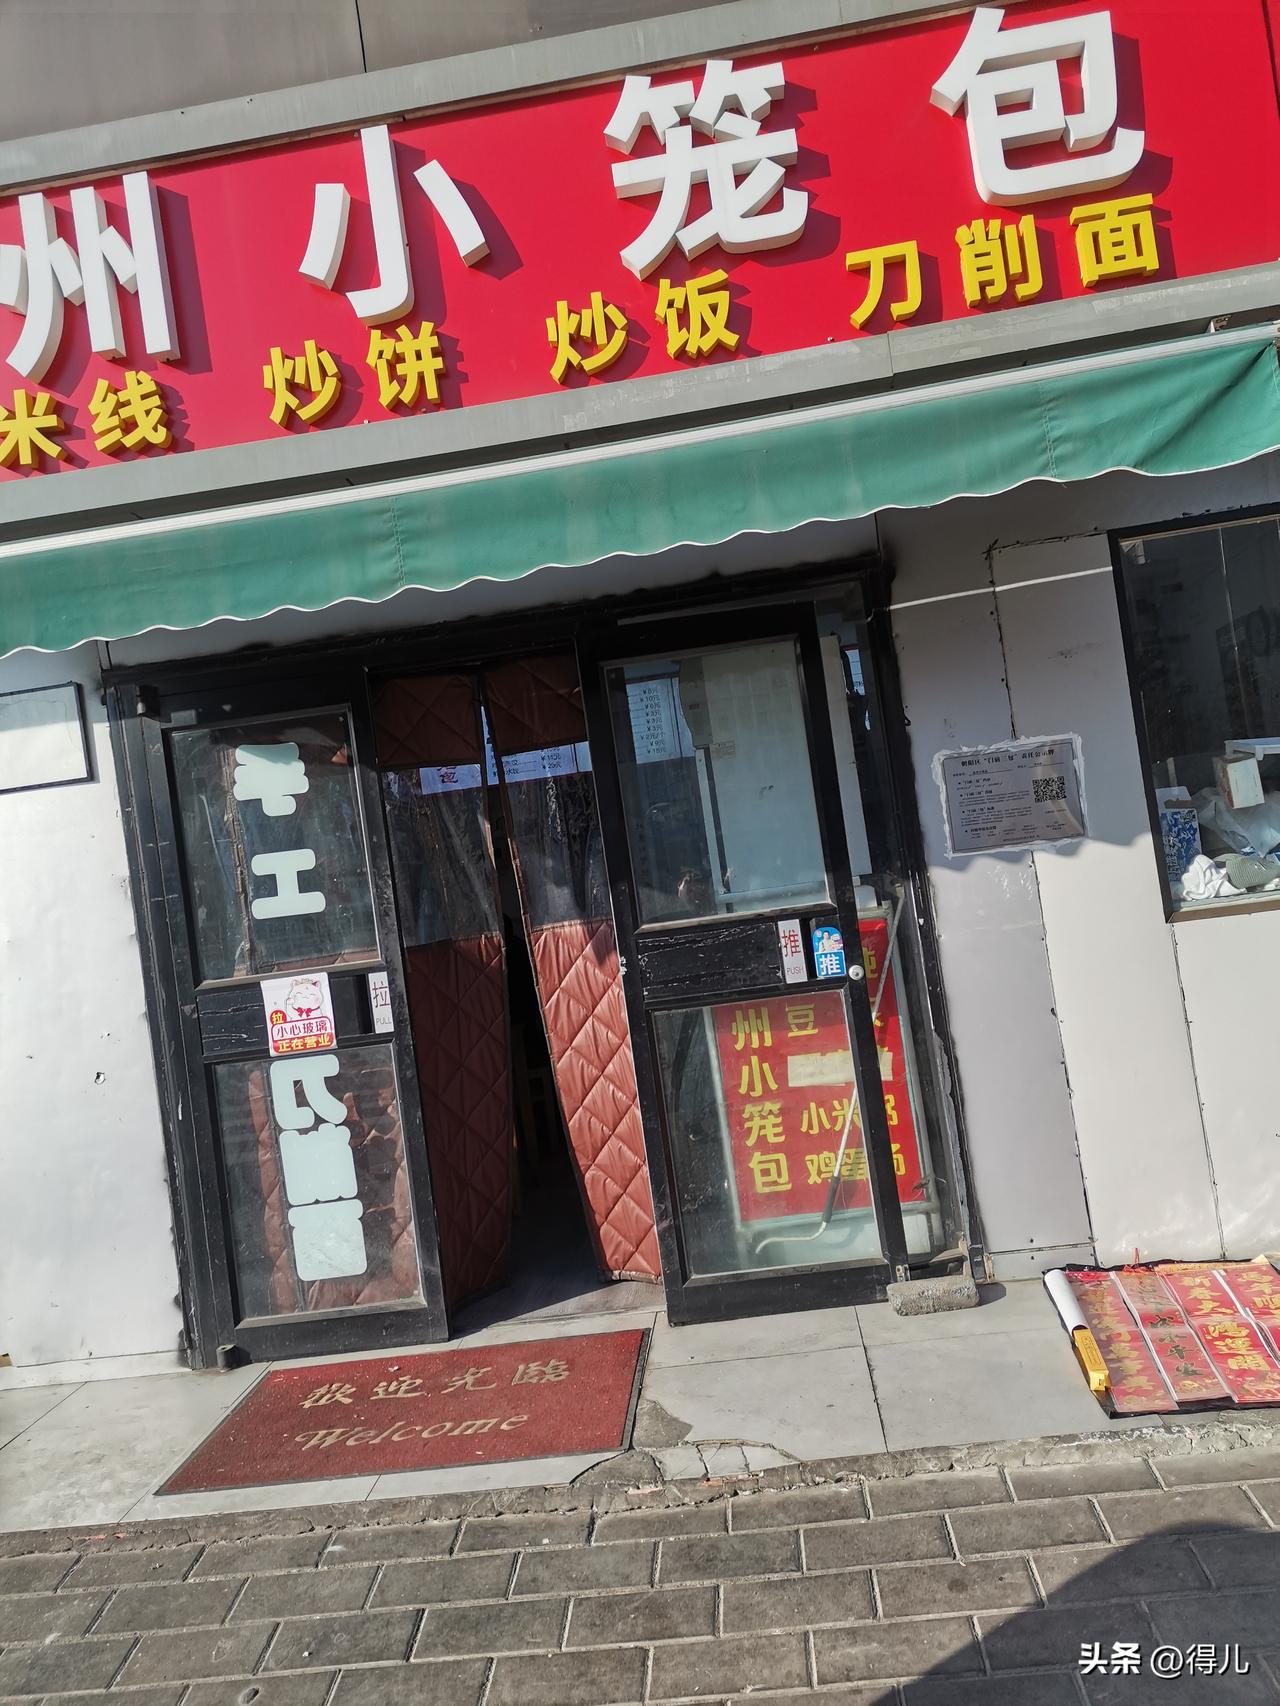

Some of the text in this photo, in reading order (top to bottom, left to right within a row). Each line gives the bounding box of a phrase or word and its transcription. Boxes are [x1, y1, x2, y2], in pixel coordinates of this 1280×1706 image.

[0, 8, 1145, 386] 州小笼包
[0, 193, 1161, 465] 米线 炒饼 炒饭 刀削面
[782, 929, 801, 957] 推
[787, 966, 804, 975] PUSH
[819, 953, 842, 975] 推
[372, 981, 390, 1008] 拉
[271, 1012, 284, 1025] 拉
[276, 1019, 328, 1038] 小心玻璃
[375, 1017, 392, 1025] PULL
[278, 1032, 331, 1052] 正在营业
[732, 1006, 792, 1193] 州小笼包
[294, 1414, 529, 1451] Welcome
